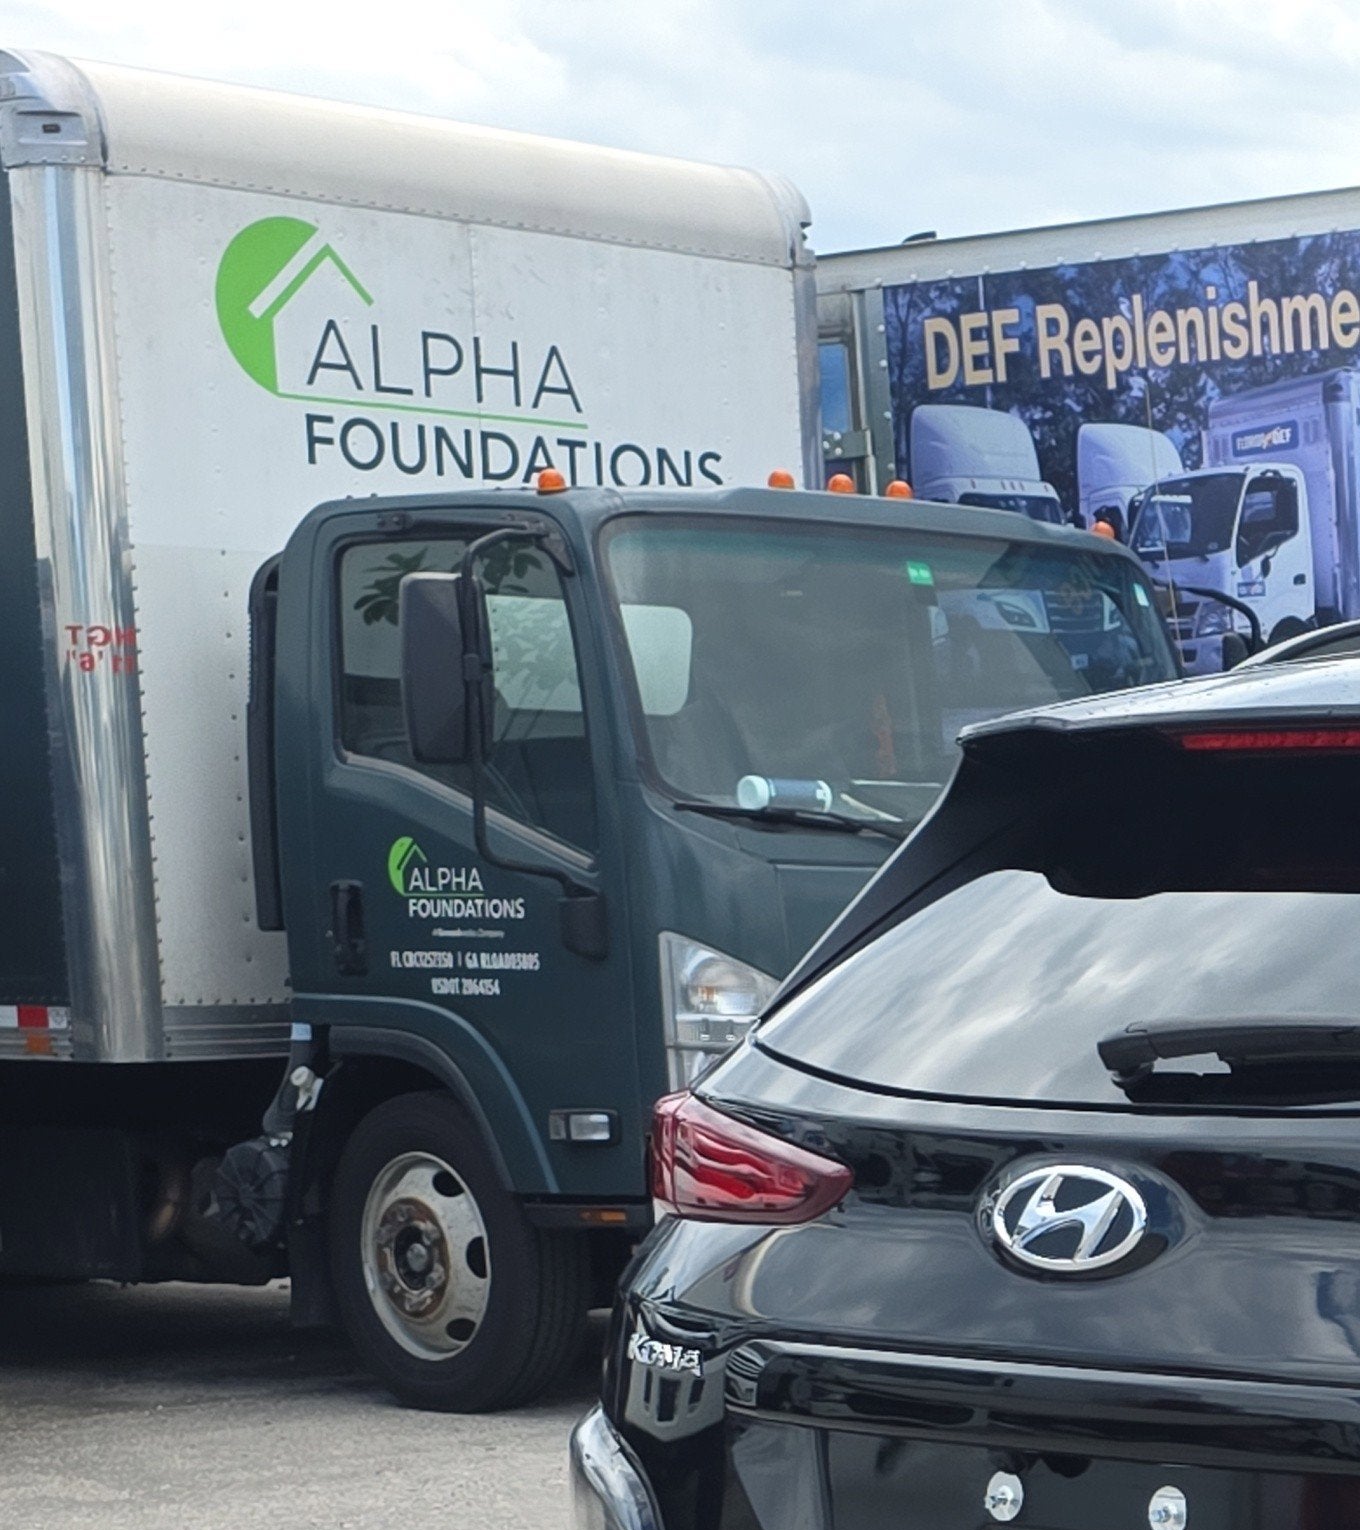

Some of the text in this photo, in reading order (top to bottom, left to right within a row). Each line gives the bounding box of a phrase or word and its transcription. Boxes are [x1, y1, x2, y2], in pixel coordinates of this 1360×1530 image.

[306, 318, 584, 414] ALPHA
[922, 308, 1023, 392] DEF
[304, 413, 725, 488] FOUNDATIONS
[408, 897, 525, 919] FOUNDATIONS
[409, 867, 484, 892] ALPHA
[627, 1333, 701, 1377] KONA
